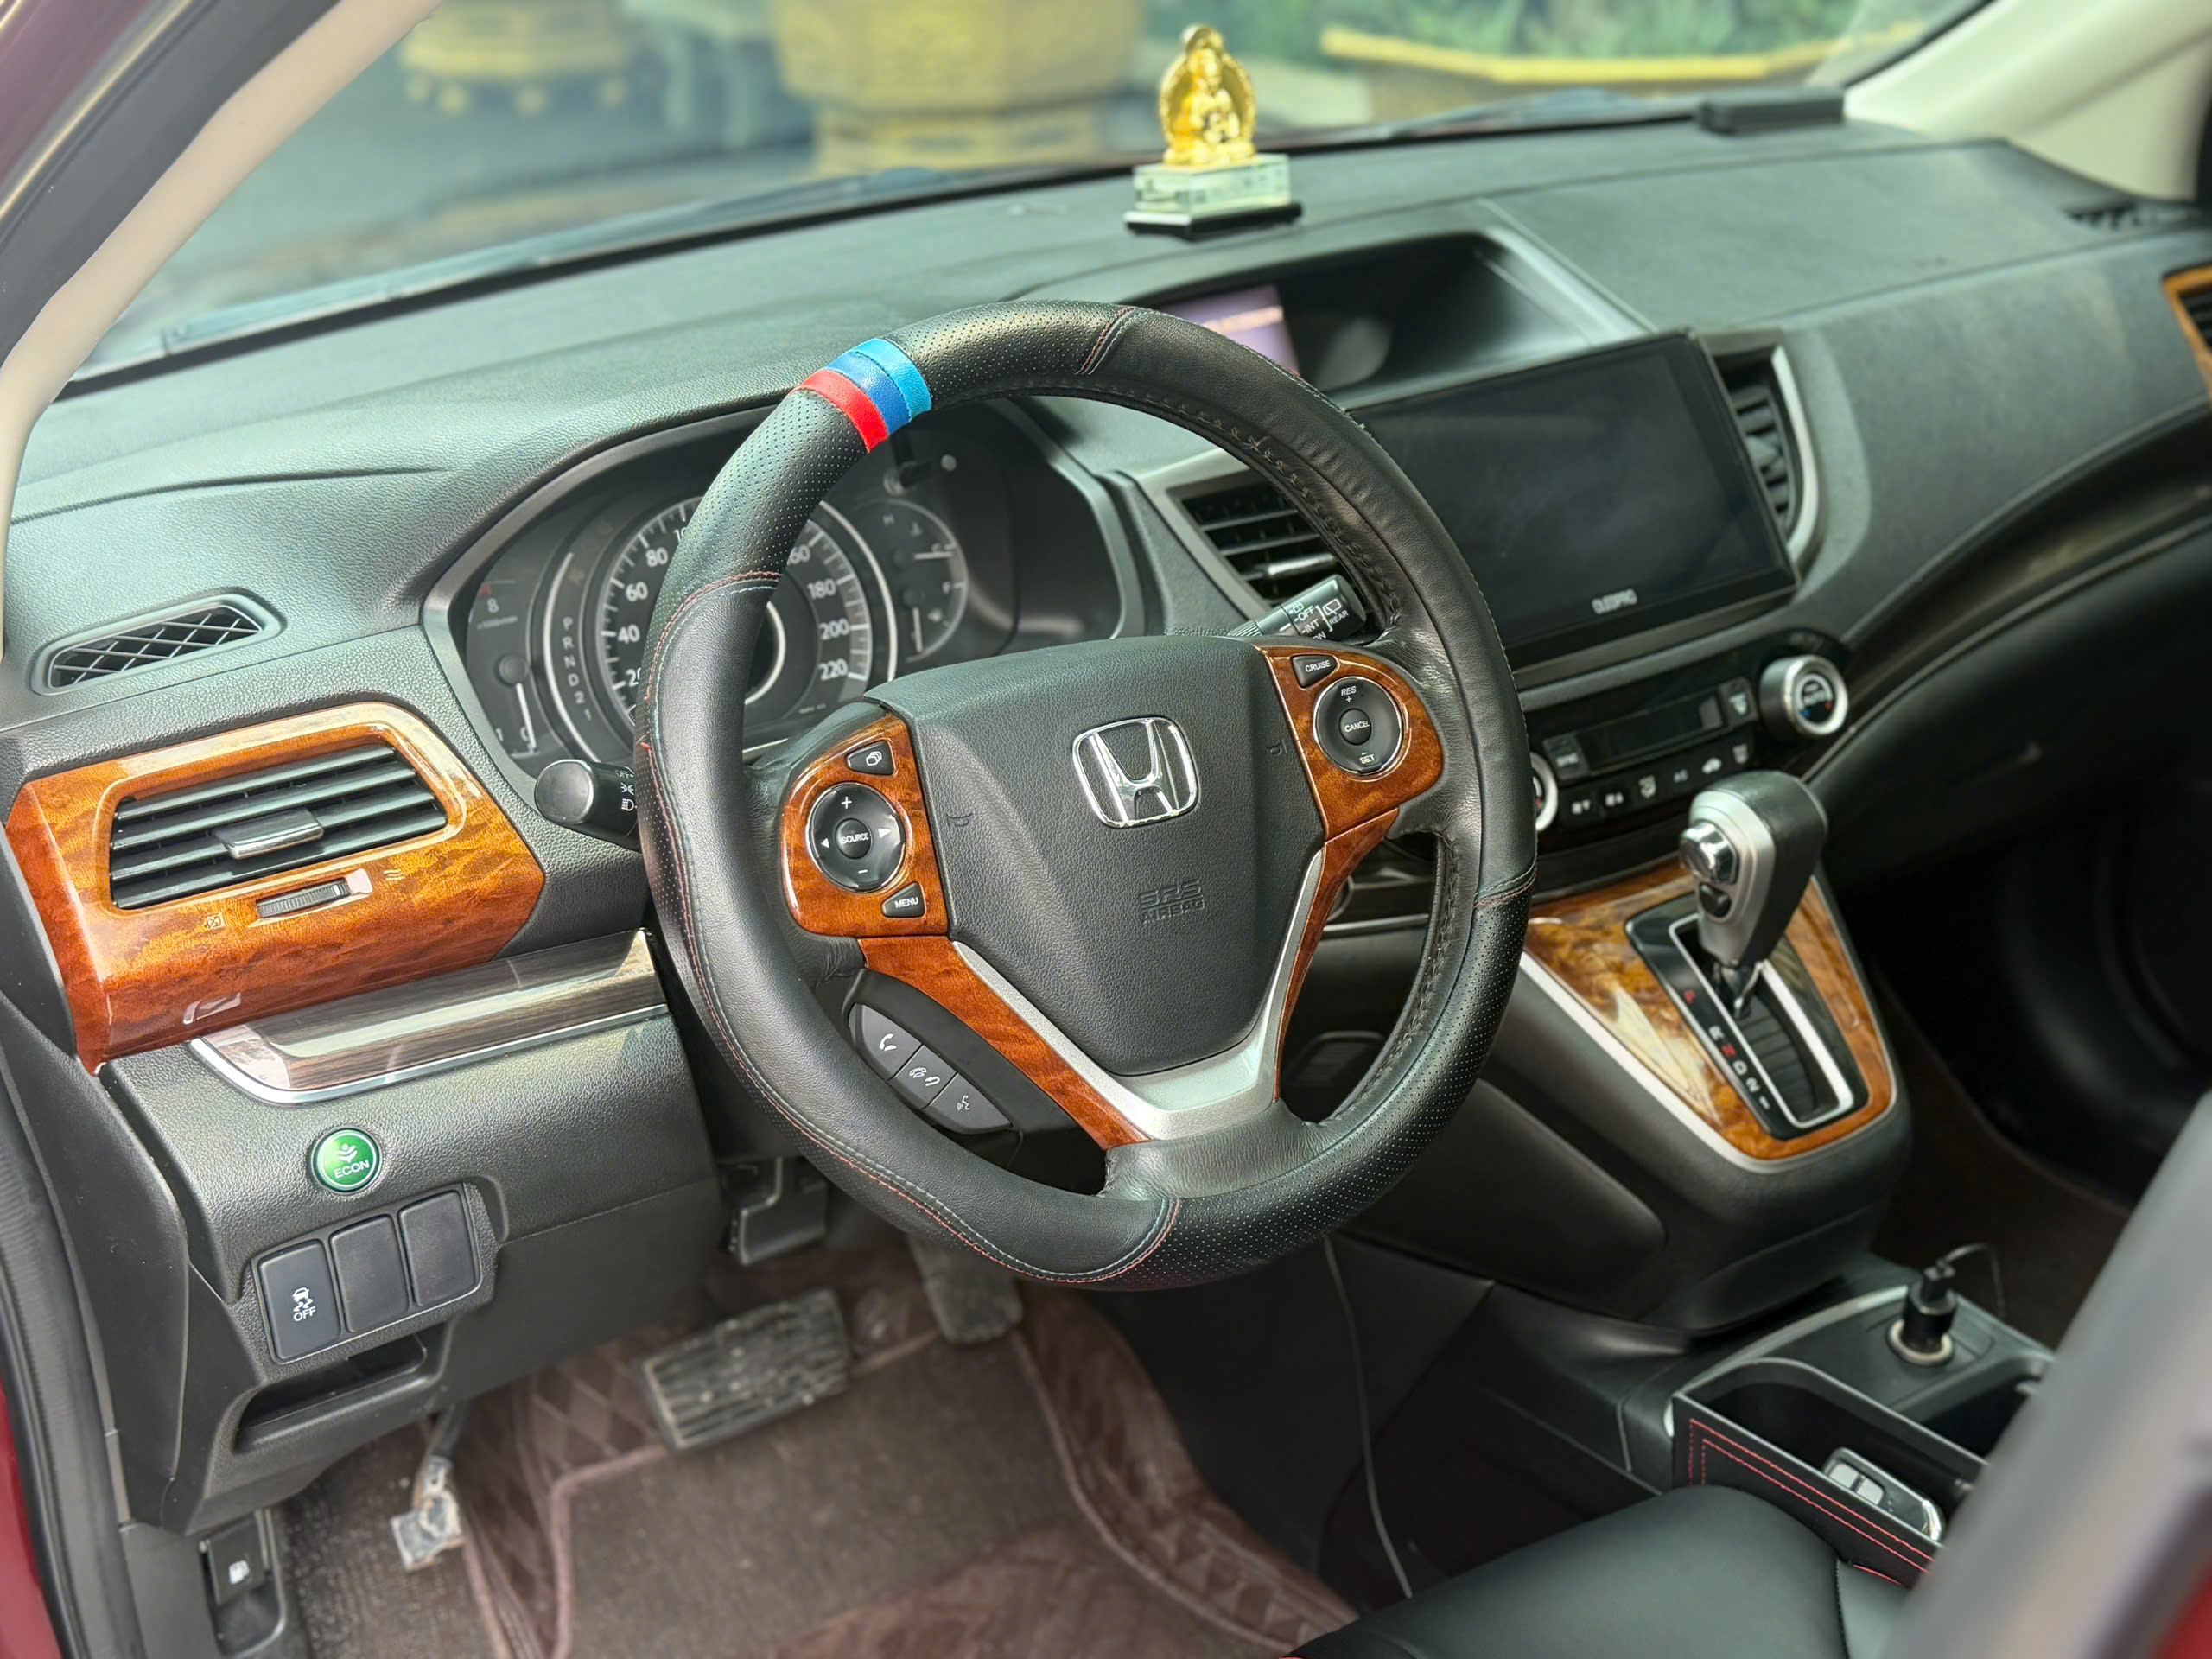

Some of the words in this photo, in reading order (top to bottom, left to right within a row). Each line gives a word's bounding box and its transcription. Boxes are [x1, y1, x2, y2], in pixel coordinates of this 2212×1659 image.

[645, 547, 669, 568] 80
[786, 544, 811, 565] 60
[626, 582, 649, 602] 60
[807, 578, 836, 600] 180
[1298, 605, 1314, 621] OFF
[1329, 610, 1349, 626] REAR
[818, 618, 850, 640] 200
[1305, 618, 1320, 633] INT
[617, 624, 641, 644] 40
[818, 658, 849, 681] 220
[1305, 659, 1332, 673] CRUISE
[568, 673, 579, 687] D
[1340, 685, 1357, 696] RES
[1344, 719, 1370, 733] CANCEL
[1359, 753, 1376, 764] SET
[840, 832, 870, 845] SOURCE
[894, 896, 919, 909] MENU
[334, 1159, 371, 1179] ECON
[293, 1306, 317, 1323] OFF
